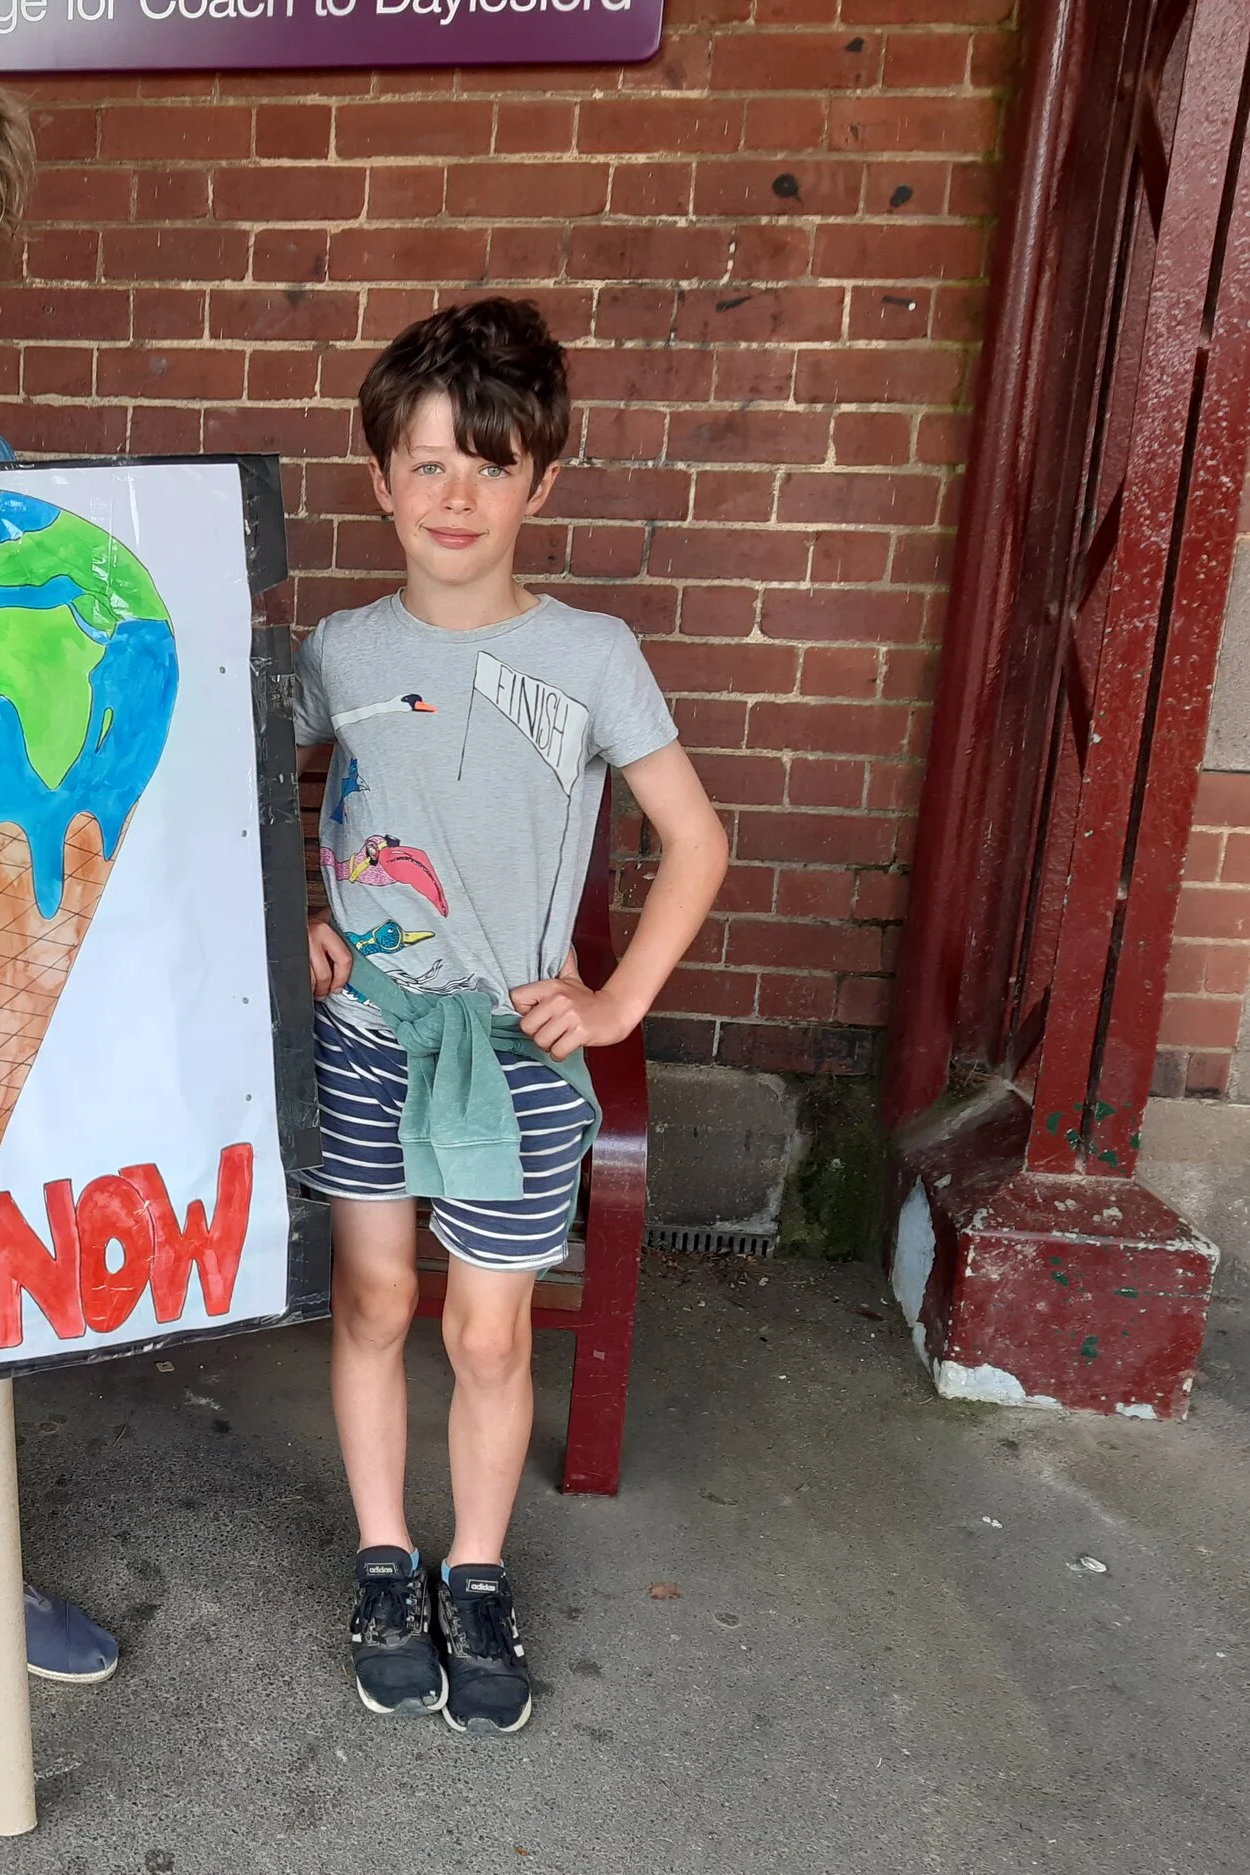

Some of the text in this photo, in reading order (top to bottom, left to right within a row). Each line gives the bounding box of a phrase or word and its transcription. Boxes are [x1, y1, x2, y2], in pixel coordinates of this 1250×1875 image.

[496, 664, 569, 768] FINISH
[369, 1565, 394, 1574] adidas
[470, 1582, 496, 1592] adidas
